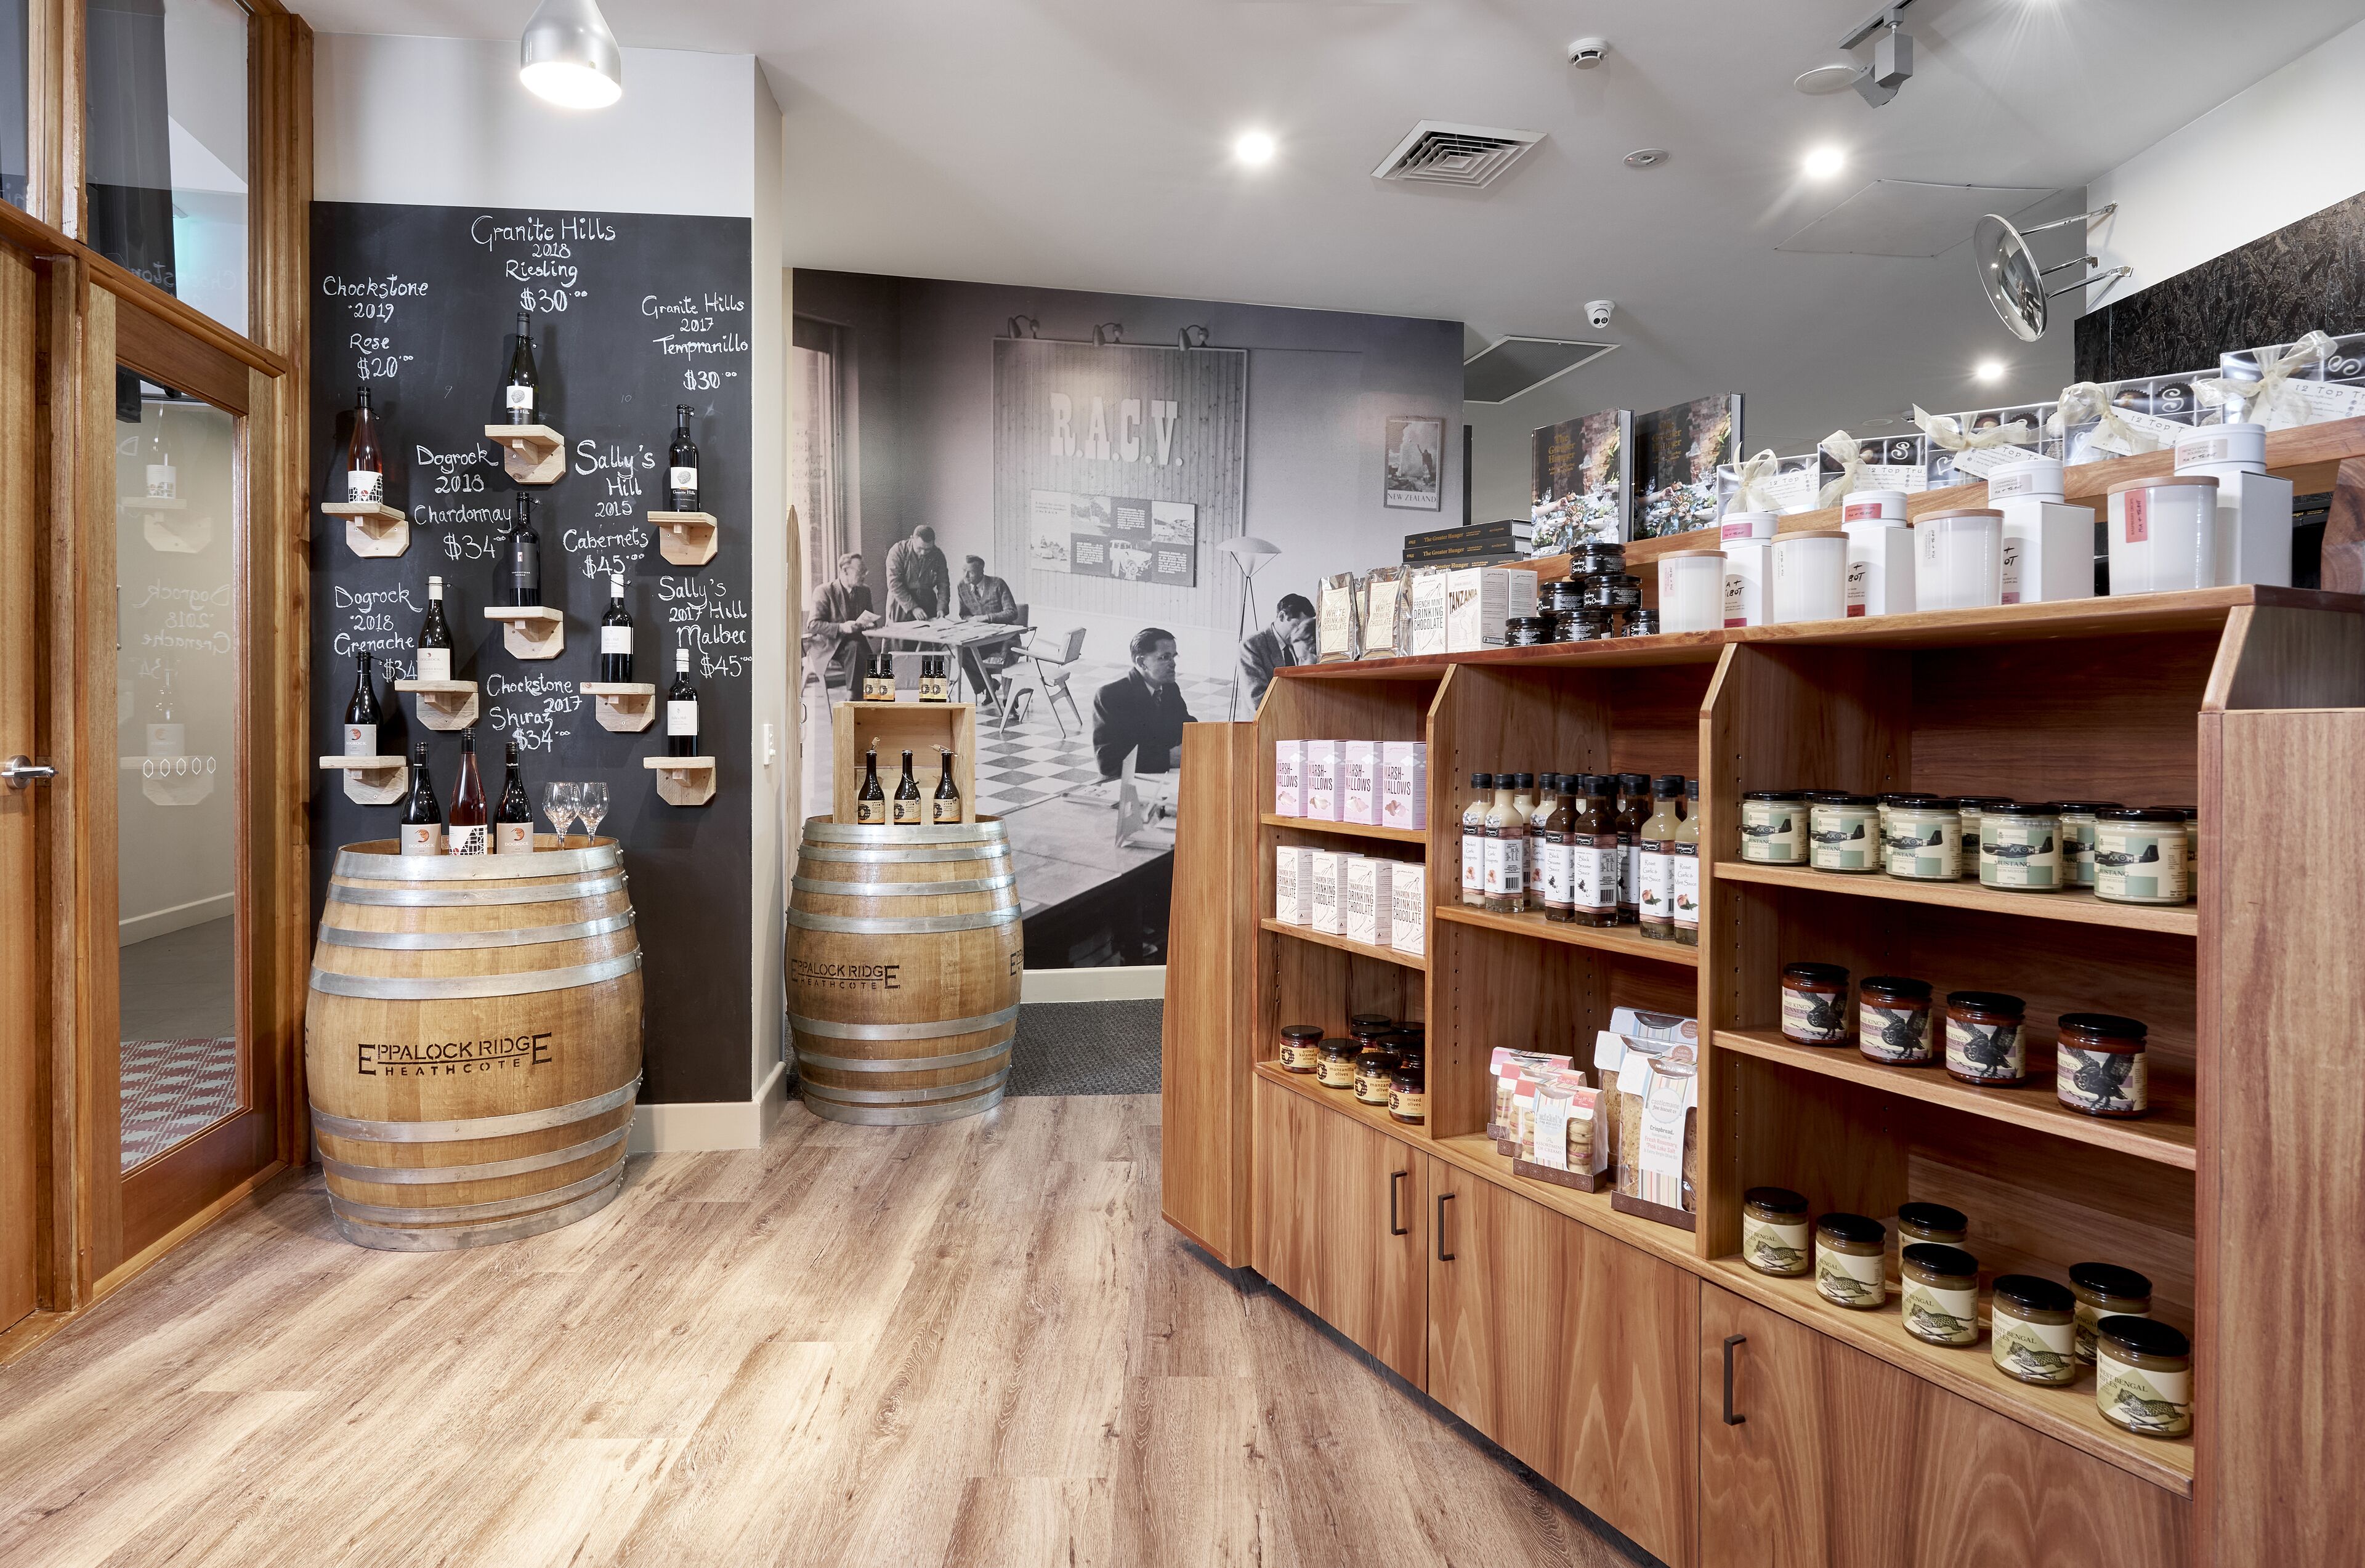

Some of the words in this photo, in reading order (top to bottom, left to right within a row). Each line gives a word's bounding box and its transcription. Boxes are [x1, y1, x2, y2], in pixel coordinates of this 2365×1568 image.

[471, 215, 554, 251] Granite
[562, 216, 616, 241] Hills
[532, 242, 571, 258] 2018
[506, 259, 578, 288] Riesling
[323, 274, 428, 298] Chockstone
[354, 302, 394, 323] 2019
[642, 295, 698, 319] Granite
[705, 292, 745, 312] Hills
[680, 317, 714, 332] 2017
[350, 333, 389, 354] Rose
[653, 333, 748, 362] Tempranillo
[2318, 387, 2343, 397] Top
[1050, 391, 1183, 467] R.A.C.V.
[2149, 419, 2170, 430] Top
[1554, 433, 1568, 443] The
[1652, 430, 1681, 442] Greater
[416, 442, 499, 474] Dogrock
[575, 439, 656, 479] Sally's
[435, 474, 484, 493] 2018
[605, 476, 642, 496] Hill
[1405, 495, 1436, 503] ZEALAND
[594, 500, 633, 518] 2015
[414, 504, 511, 533] Chardonnay
[562, 525, 649, 552] Cabernets
[334, 582, 423, 613] Dogrock
[658, 576, 727, 610] Sally's
[1375, 602, 1391, 612] WHITE
[1413, 600, 1430, 608] FRENCH
[1431, 598, 1443, 606] MINT
[1449, 588, 1478, 615] TANZANIA
[669, 607, 703, 622] 2017
[709, 600, 747, 619] Hill
[1326, 608, 1345, 618] WHITE
[1413, 606, 1443, 620] DRINKING
[354, 613, 394, 631] 2018
[1413, 617, 1443, 631] CHOCOLATE
[334, 632, 414, 658] Grenache
[676, 624, 746, 655] Malbec
[487, 673, 573, 697] Chockstone
[543, 695, 583, 713] 2017
[489, 706, 553, 734] Shiraz
[1346, 764, 1364, 777] MARSH-
[1384, 766, 1404, 780] MARSH-
[1309, 777, 1333, 790] MALLOWS
[1345, 777, 1371, 792] MALLOWS
[1384, 780, 1410, 795] MALLOWS
[2097, 868, 2129, 877] MUSTANG
[1313, 883, 1335, 895] DRINKING
[1364, 885, 1373, 894] SPICE
[1393, 889, 1410, 899] CINNAMON
[1410, 892, 1421, 901] SPICE
[1313, 892, 1335, 907] CHOCOLATE
[1348, 890, 1373, 905] DRINKING
[1393, 897, 1421, 912] DRINKING
[1348, 900, 1373, 916] CHOCOLATE
[1393, 908, 1421, 925] CHOCOLATE
[791, 959, 845, 982] EPPALOCK
[849, 964, 900, 990] RIDGE
[801, 979, 876, 990] HEATHCOTE
[358, 1040, 472, 1076] EPPALOCK
[479, 1032, 552, 1065] RIDGE
[385, 1058, 520, 1076] HEATHCOTE
[1651, 1099, 1680, 1109] castlemaine
[1536, 1142, 1564, 1150] ASSORTMENT
[1753, 1232, 1777, 1242] BENGAL
[1909, 1293, 1934, 1306] BENGAL
[1994, 1324, 2007, 1335] WEST
[2007, 1330, 2037, 1344] BENGAL
[1994, 1329, 2010, 1342] RIFLES
[2100, 1368, 2114, 1381] WEST
[2114, 1377, 2148, 1392] BENGAL
[2100, 1375, 2117, 1389] RIFLES
